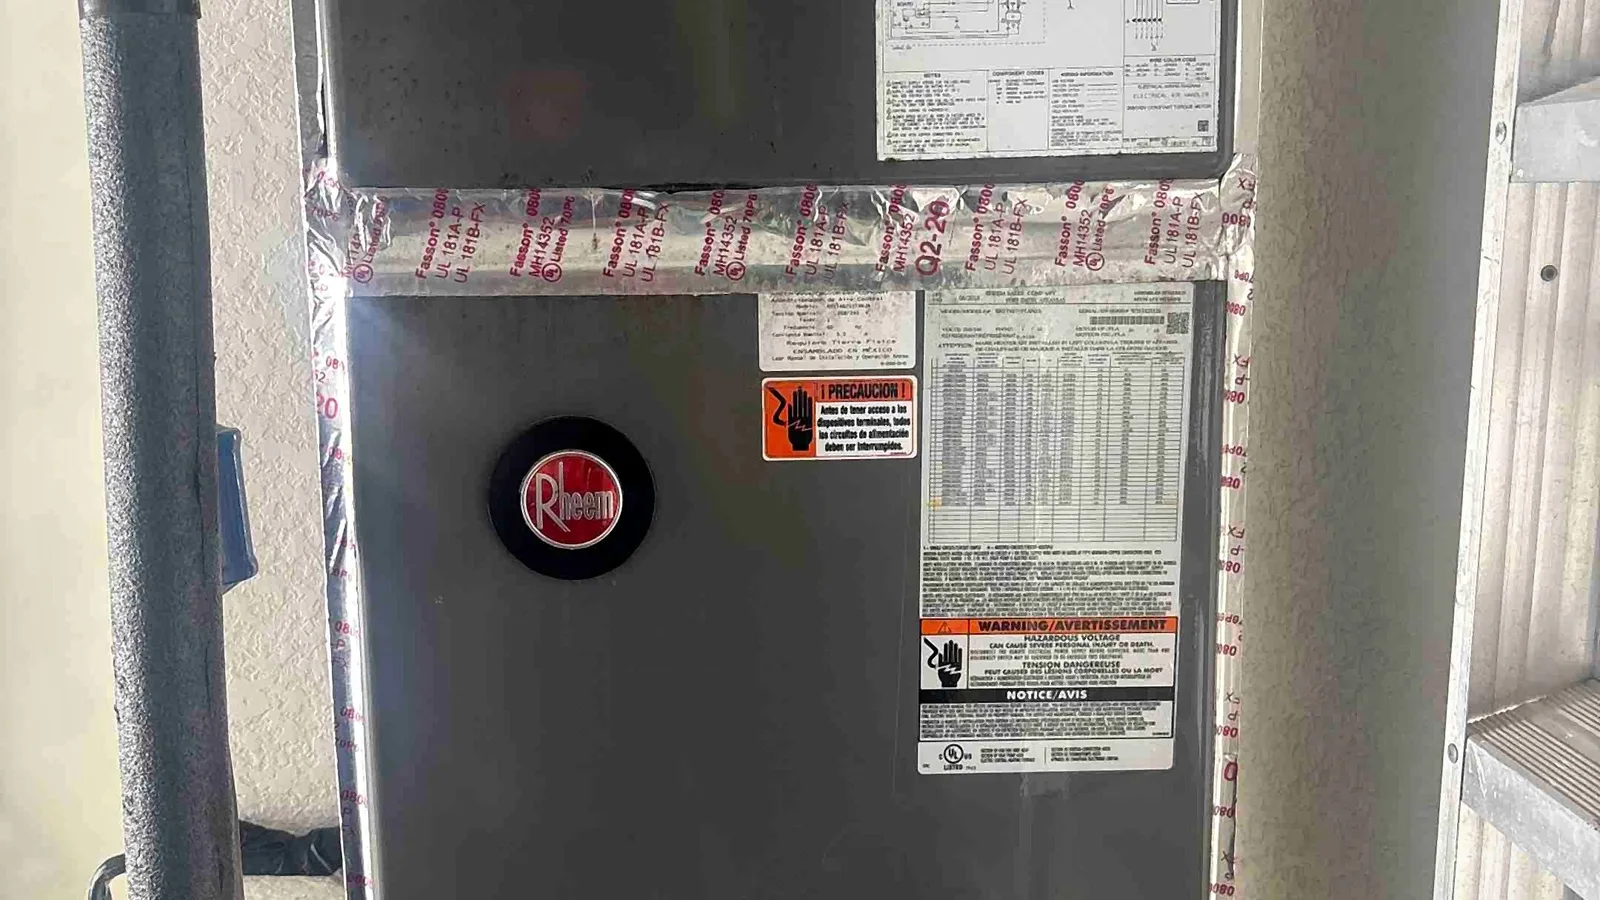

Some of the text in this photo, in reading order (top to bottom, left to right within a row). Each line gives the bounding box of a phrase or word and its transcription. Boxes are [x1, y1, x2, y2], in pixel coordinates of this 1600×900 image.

[436, 206, 464, 278] UL 181A-P
[455, 201, 486, 284] UL 181B-FX
[528, 216, 555, 278] MH14352
[551, 228, 568, 262] Listed
[623, 206, 650, 277] UL 181A-P
[642, 202, 670, 282] UL 181B-FX
[713, 216, 738, 276] MH14352
[735, 226, 751, 260] Listed
[744, 194, 758, 222] 70P6
[805, 206, 830, 276] UL 181A-P
[825, 202, 849, 282] UL 181B-FX
[894, 213, 916, 272] MH14352
[915, 200, 950, 276] Q2-20
[984, 202, 1006, 271] UL 181A-P
[1002, 197, 1028, 274] UL 181B-FX
[1073, 210, 1093, 267] MH14352
[1093, 220, 1106, 252] Listed
[1164, 196, 1184, 264] UL 181A-P
[1182, 192, 1205, 268] UL 181B-FX
[818, 416, 910, 428] dispositivos terminales, todos
[820, 405, 838, 414] Antes
[840, 405, 848, 414] de
[850, 406, 866, 414] tener
[868, 406, 890, 414] acceso
[897, 404, 907, 414] los
[828, 383, 898, 399] PRECAUCION
[819, 430, 828, 439] los
[830, 430, 858, 439] circuitos
[859, 430, 867, 438] de
[825, 442, 844, 452] deben
[846, 444, 856, 452] ser
[536, 462, 614, 532] Rheem
[978, 619, 1167, 632] WARNING/AVERTISSEMENT
[1006, 690, 1088, 700] NOTICE/AVIS
